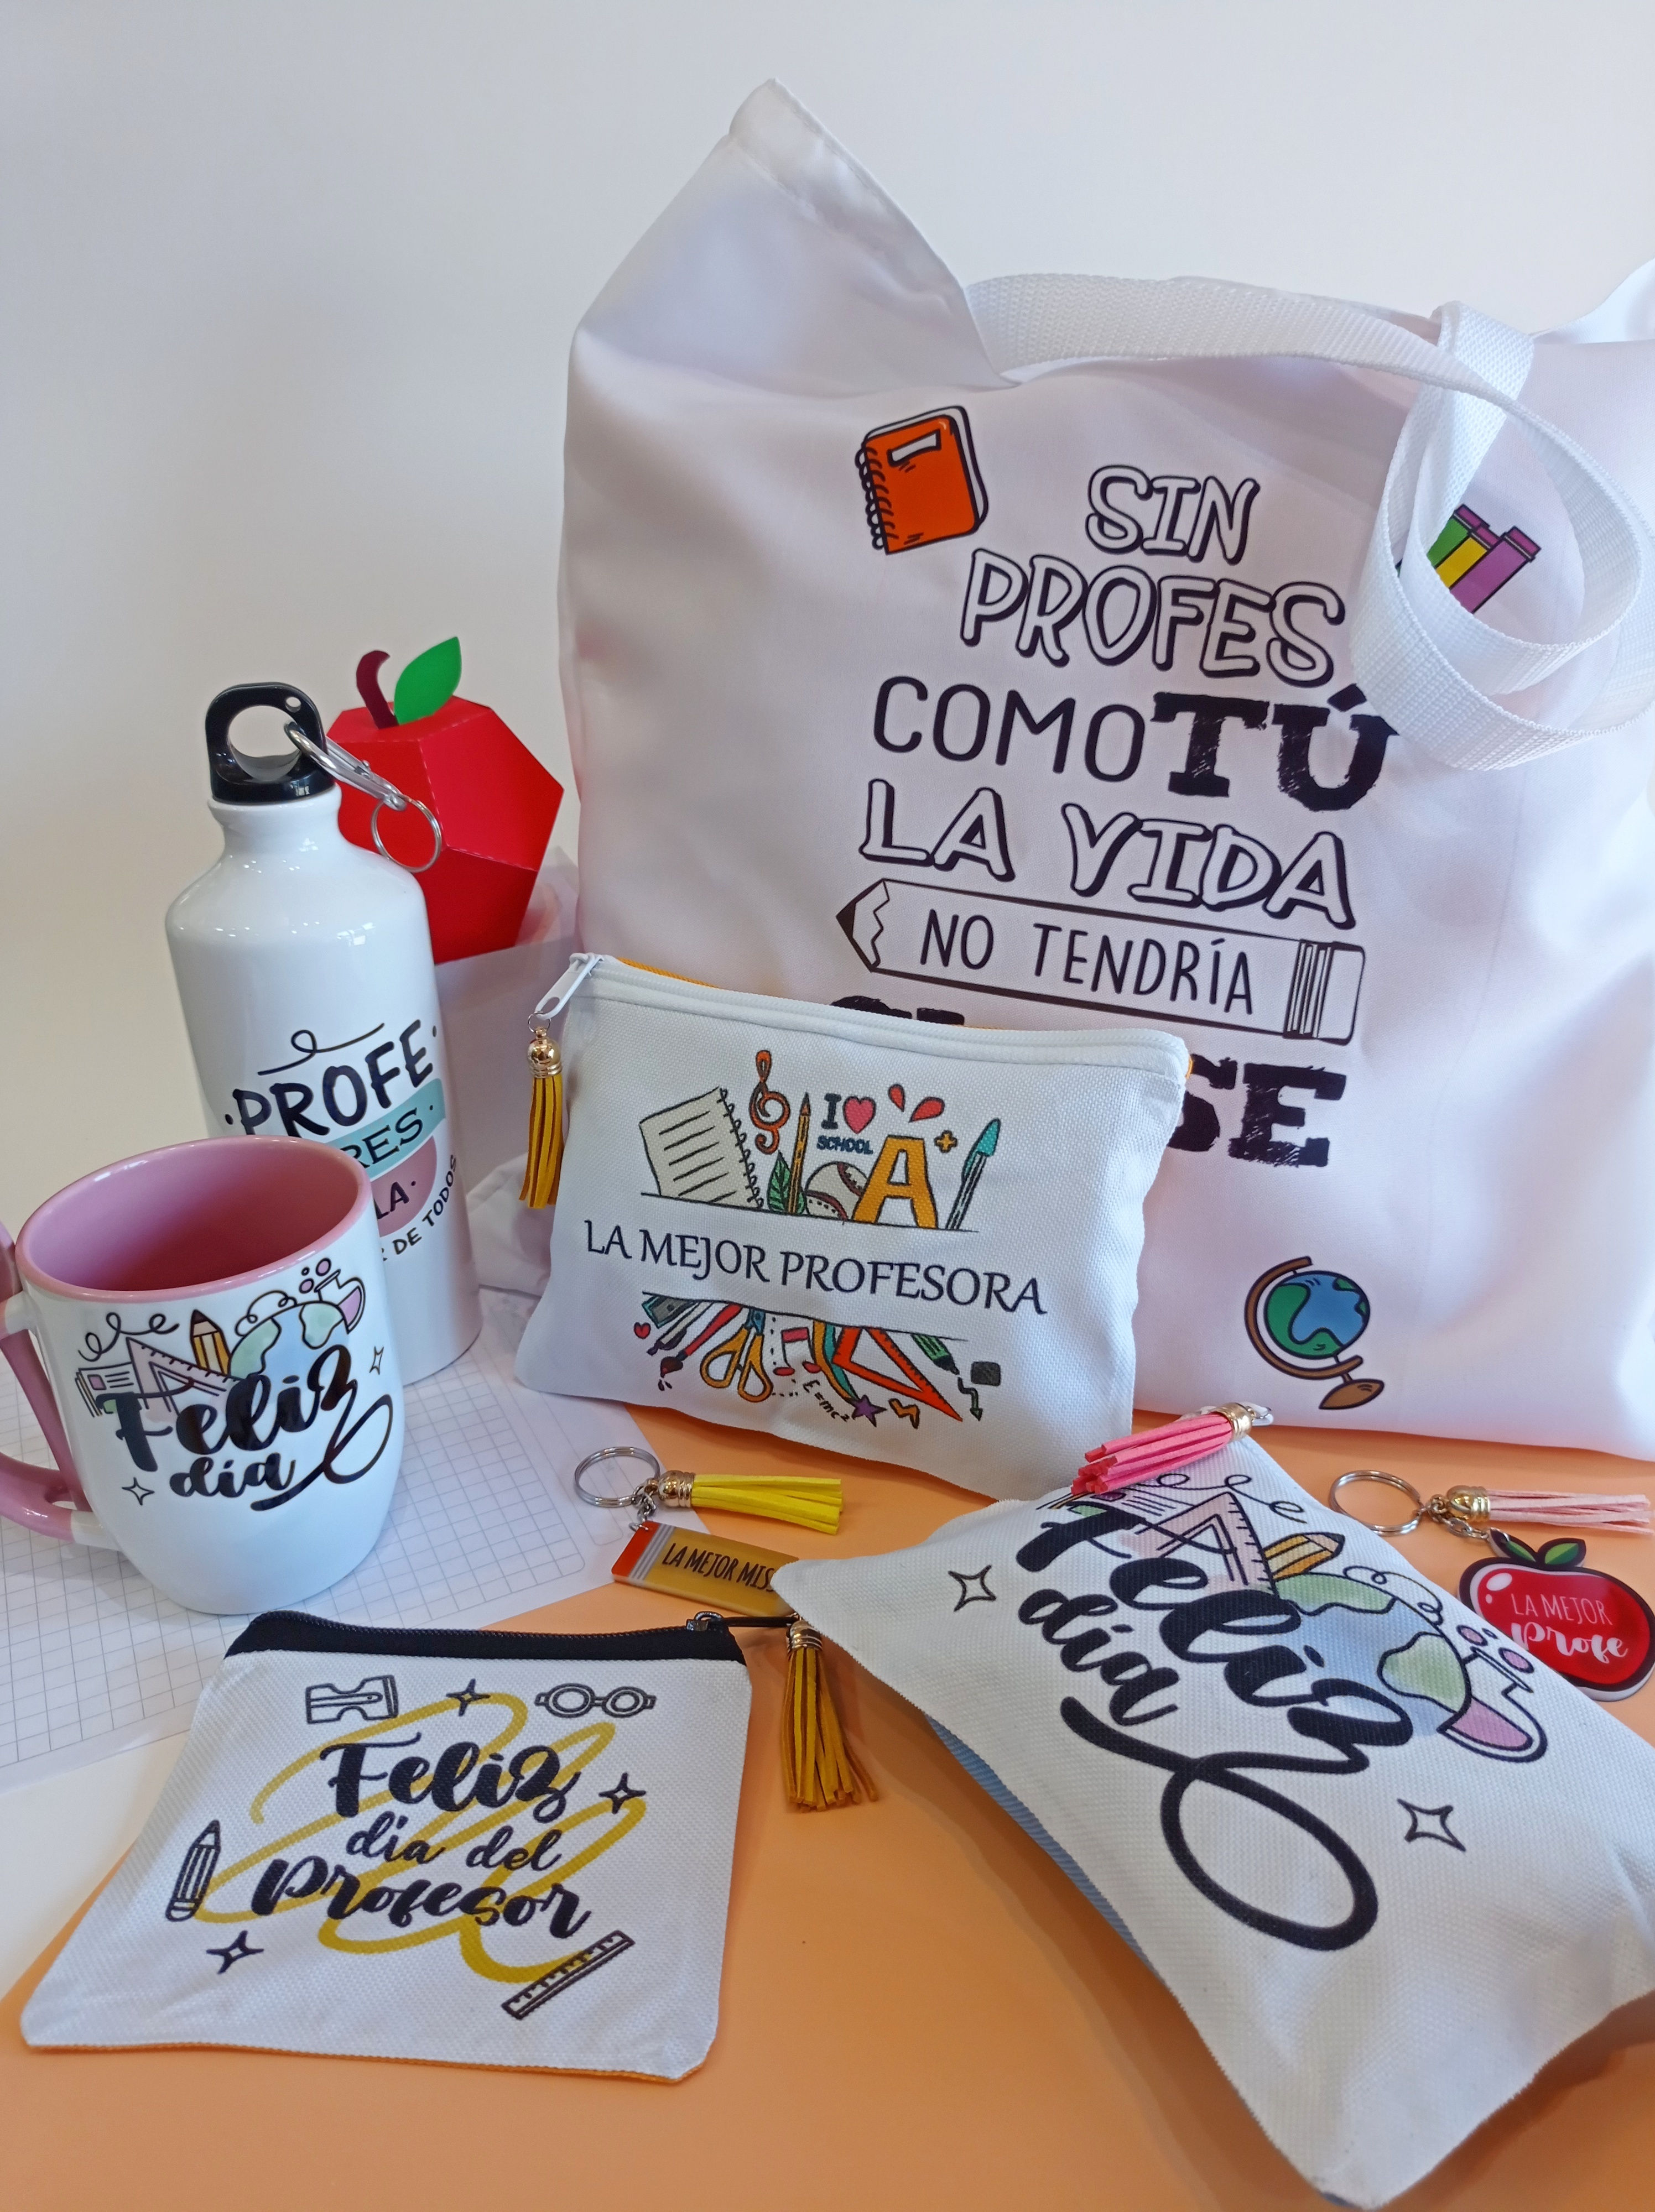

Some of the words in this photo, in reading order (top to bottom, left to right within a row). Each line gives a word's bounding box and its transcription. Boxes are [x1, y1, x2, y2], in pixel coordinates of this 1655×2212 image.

[1086, 465, 1257, 565] SIN
[960, 549, 1346, 687] PROFES
[873, 676, 1146, 782] COMO
[1151, 684, 1399, 812] TÚ
[859, 779, 1016, 883] LA
[1061, 804, 1356, 929] VIDA
[919, 909, 994, 969] NO
[1034, 922, 1254, 1015] TENDRÍA
[232, 1019, 434, 1136] PROFE
[340, 1108, 424, 1169] RES
[816, 1135, 873, 1155] SCHOOL
[392, 1227, 423, 1255] DE
[422, 1155, 456, 1227] TODOS
[584, 1220, 632, 1259] LA
[640, 1229, 770, 1282] MEJOR
[780, 1251, 1047, 1314] PROFESORA
[95, 1345, 393, 1511] Feliz
[662, 1543, 688, 1567] LA
[684, 1548, 739, 1581] MEJOR
[736, 1562, 776, 1592] MIS
[1511, 1594, 1538, 1616] LA
[1540, 1594, 1612, 1625] MEJOR
[1016, 1500, 1413, 1951] Feliz
[320, 1731, 582, 1823] Feliz
[465, 1825, 562, 1871] del
